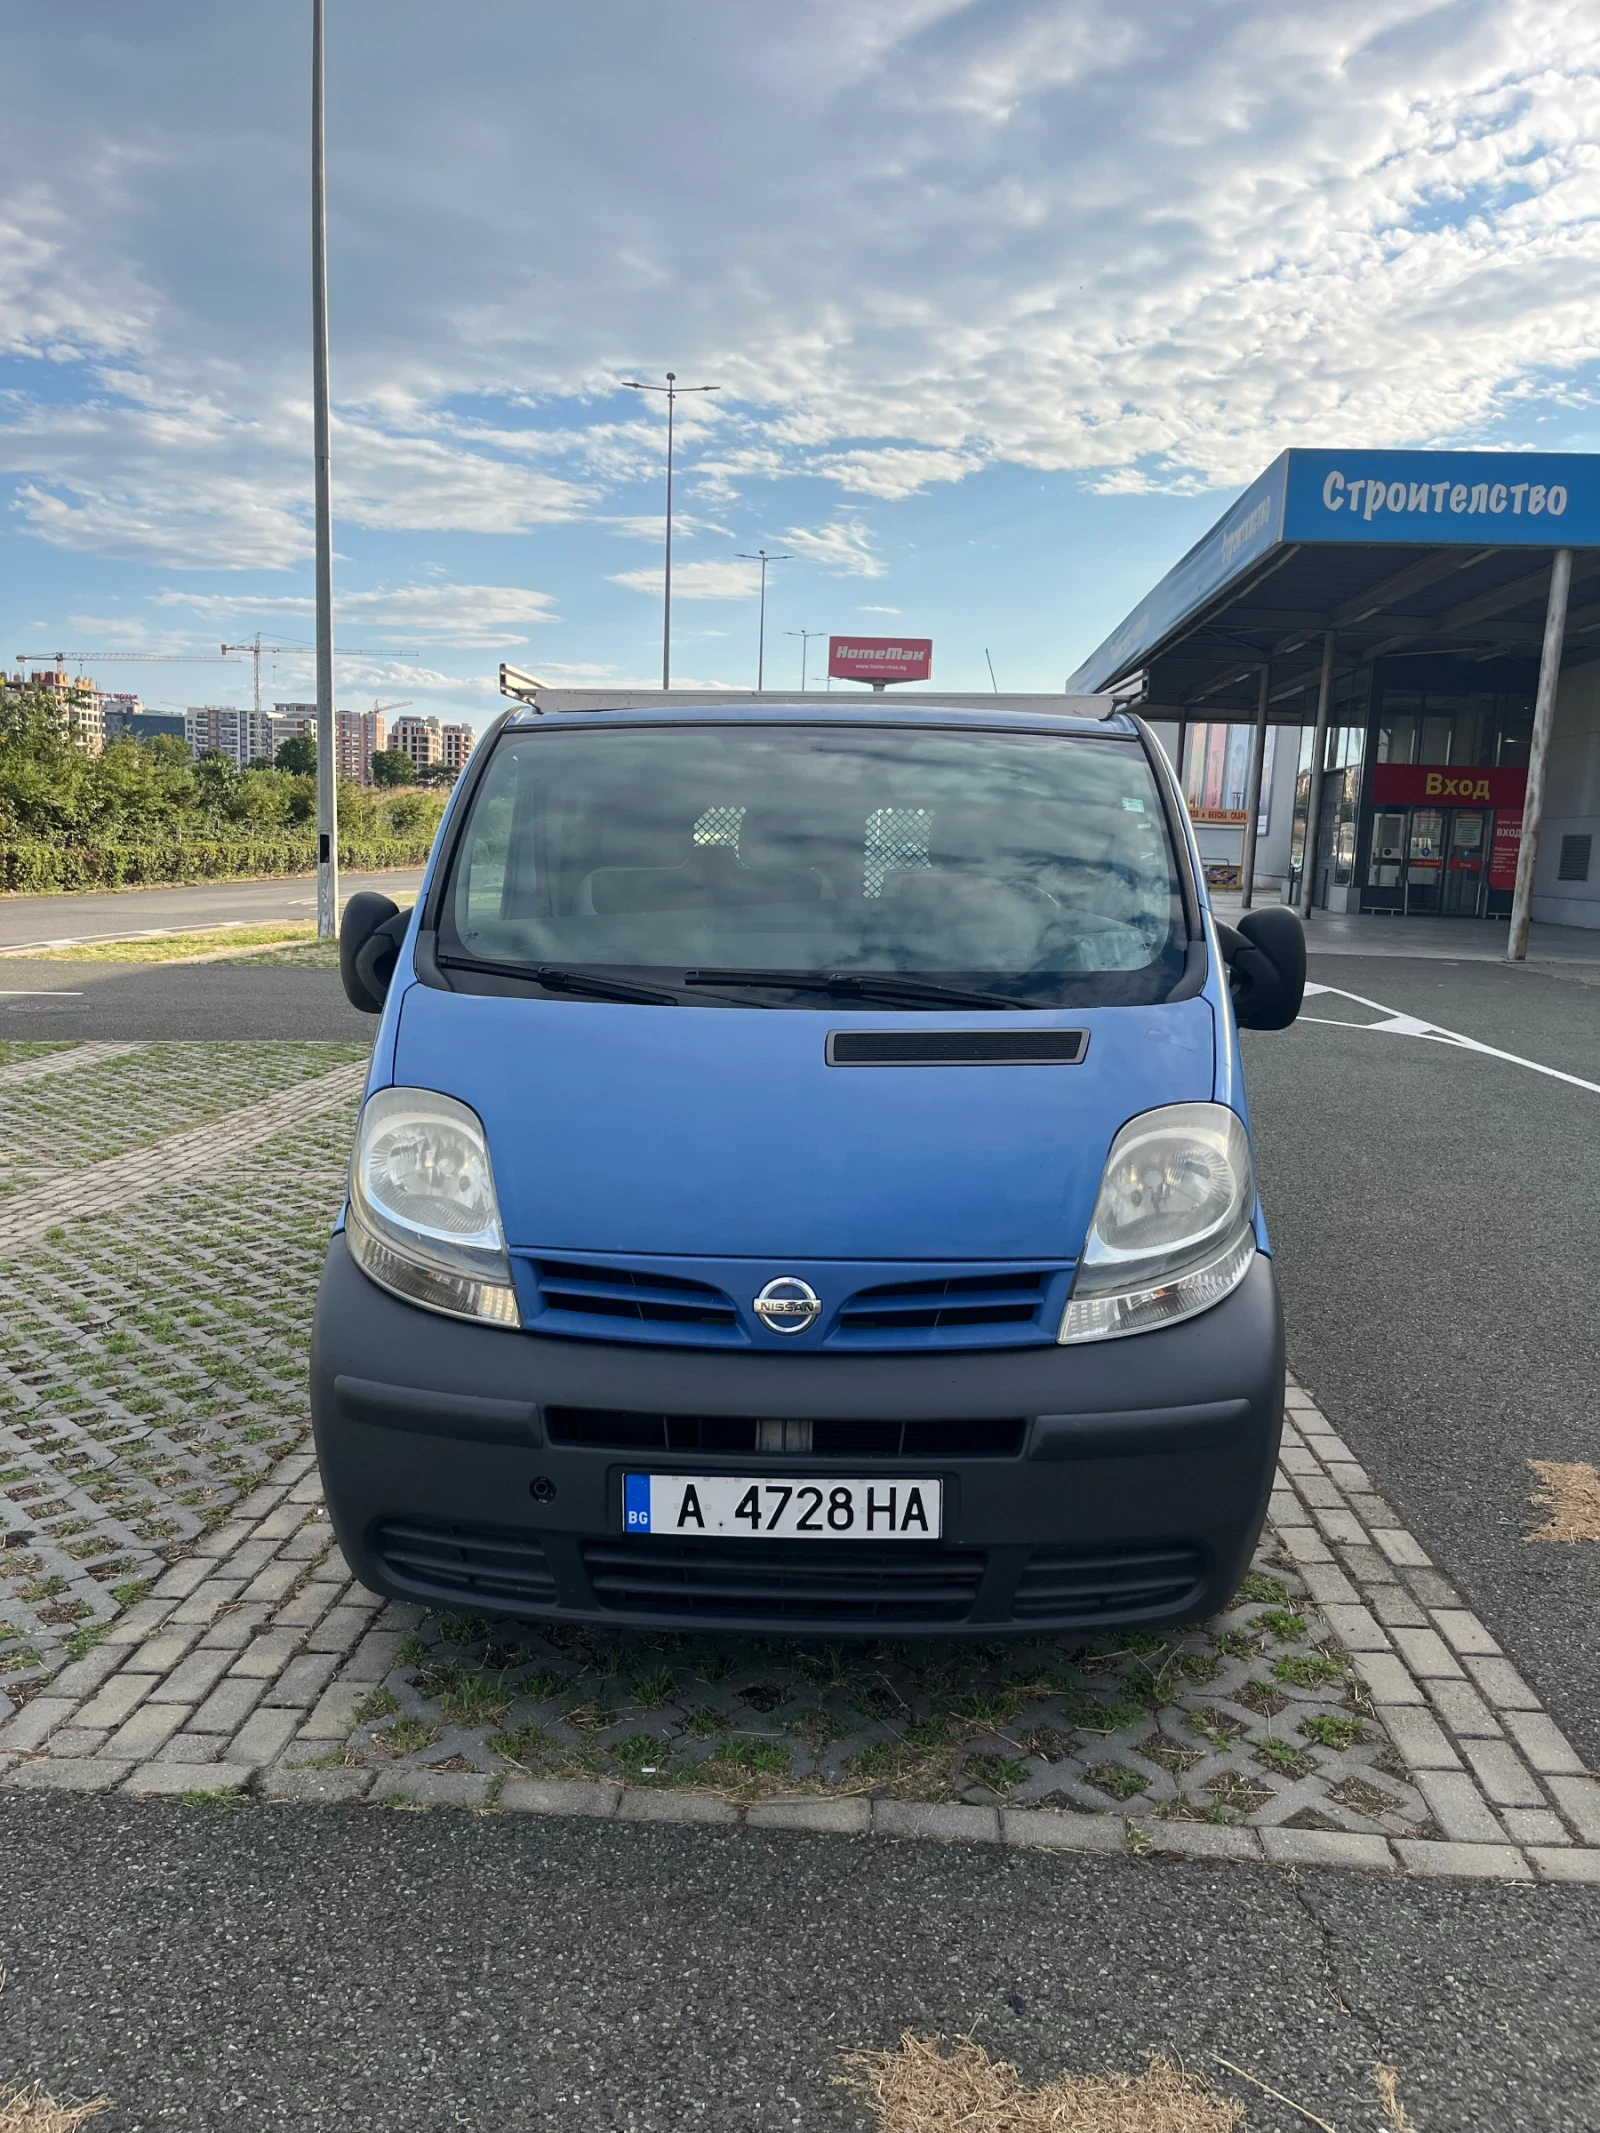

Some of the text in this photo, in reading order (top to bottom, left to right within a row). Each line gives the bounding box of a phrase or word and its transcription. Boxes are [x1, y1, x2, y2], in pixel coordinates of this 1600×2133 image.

[1322, 470, 1568, 521] Строителство
[836, 646, 924, 660] HomeMax
[1425, 773, 1490, 800] Вход
[1208, 811, 1227, 819] ВКУСНА
[1231, 811, 1247, 820] СКАРА
[760, 1302, 814, 1312] NISSAN
[676, 1483, 929, 1532] A 4728 HA
[628, 1511, 648, 1525] BG
